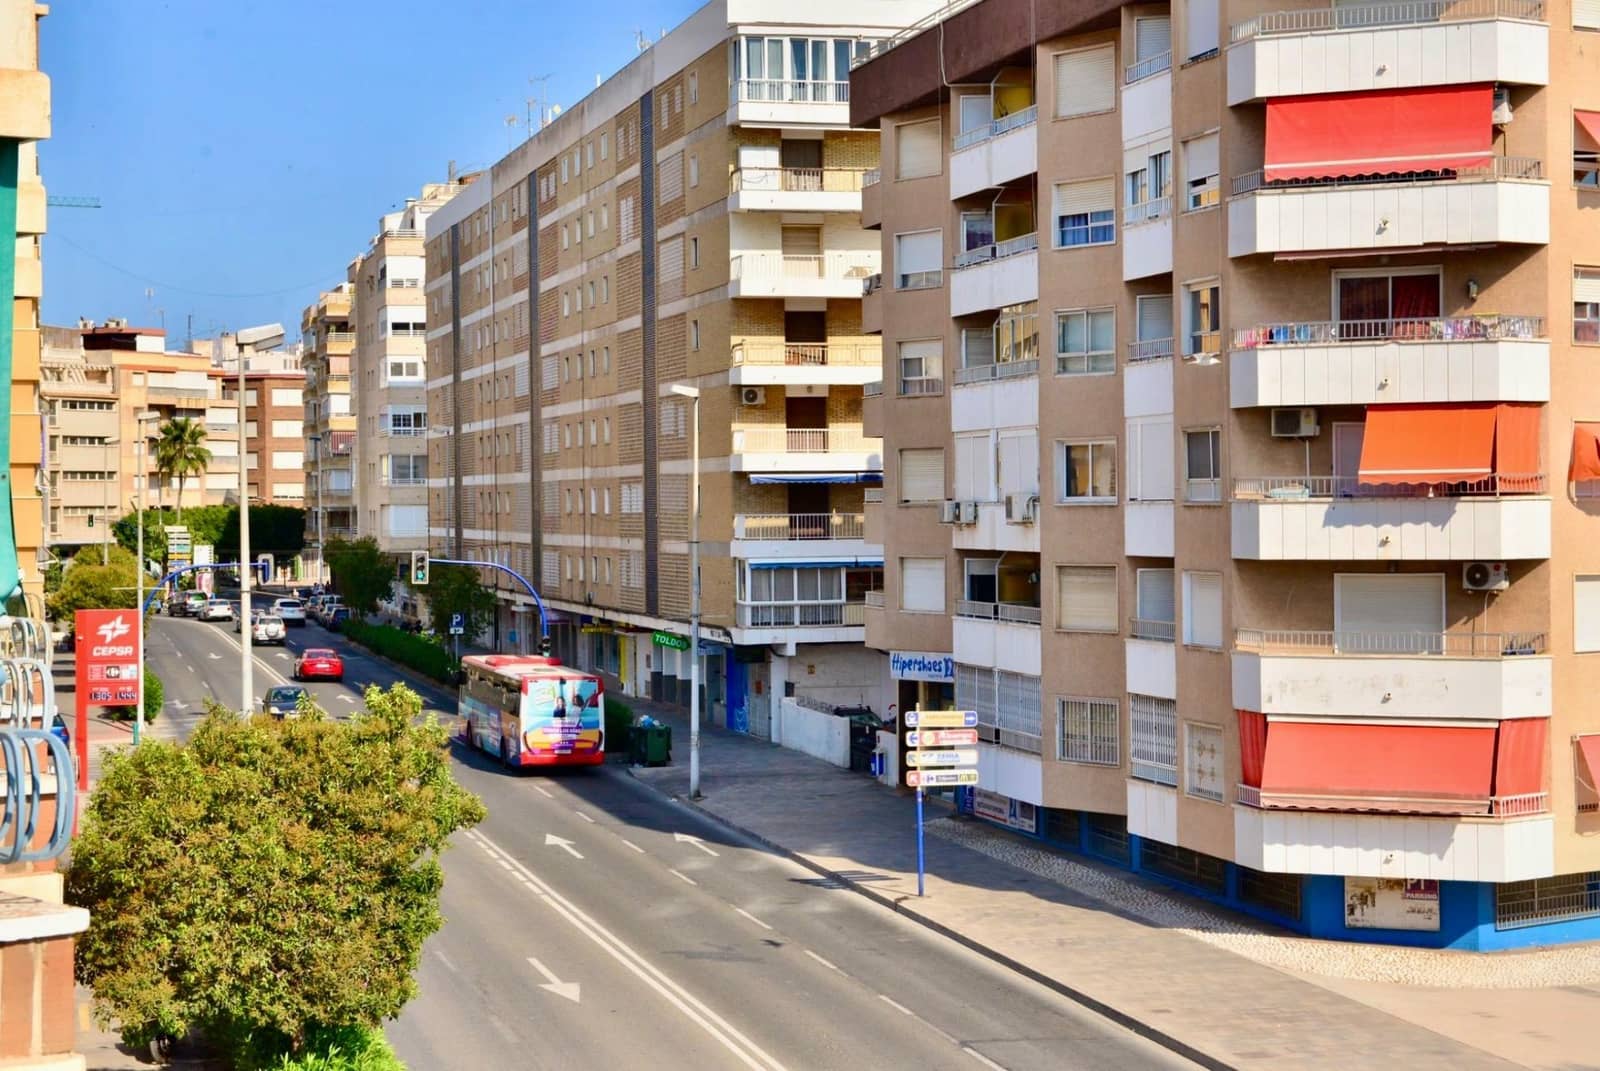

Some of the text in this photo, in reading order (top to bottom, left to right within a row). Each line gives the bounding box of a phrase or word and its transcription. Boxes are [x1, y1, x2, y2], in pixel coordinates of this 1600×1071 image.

[453, 614, 461, 625] P
[92, 646, 133, 656] CEPSA
[892, 653, 943, 677] Hipershoes
